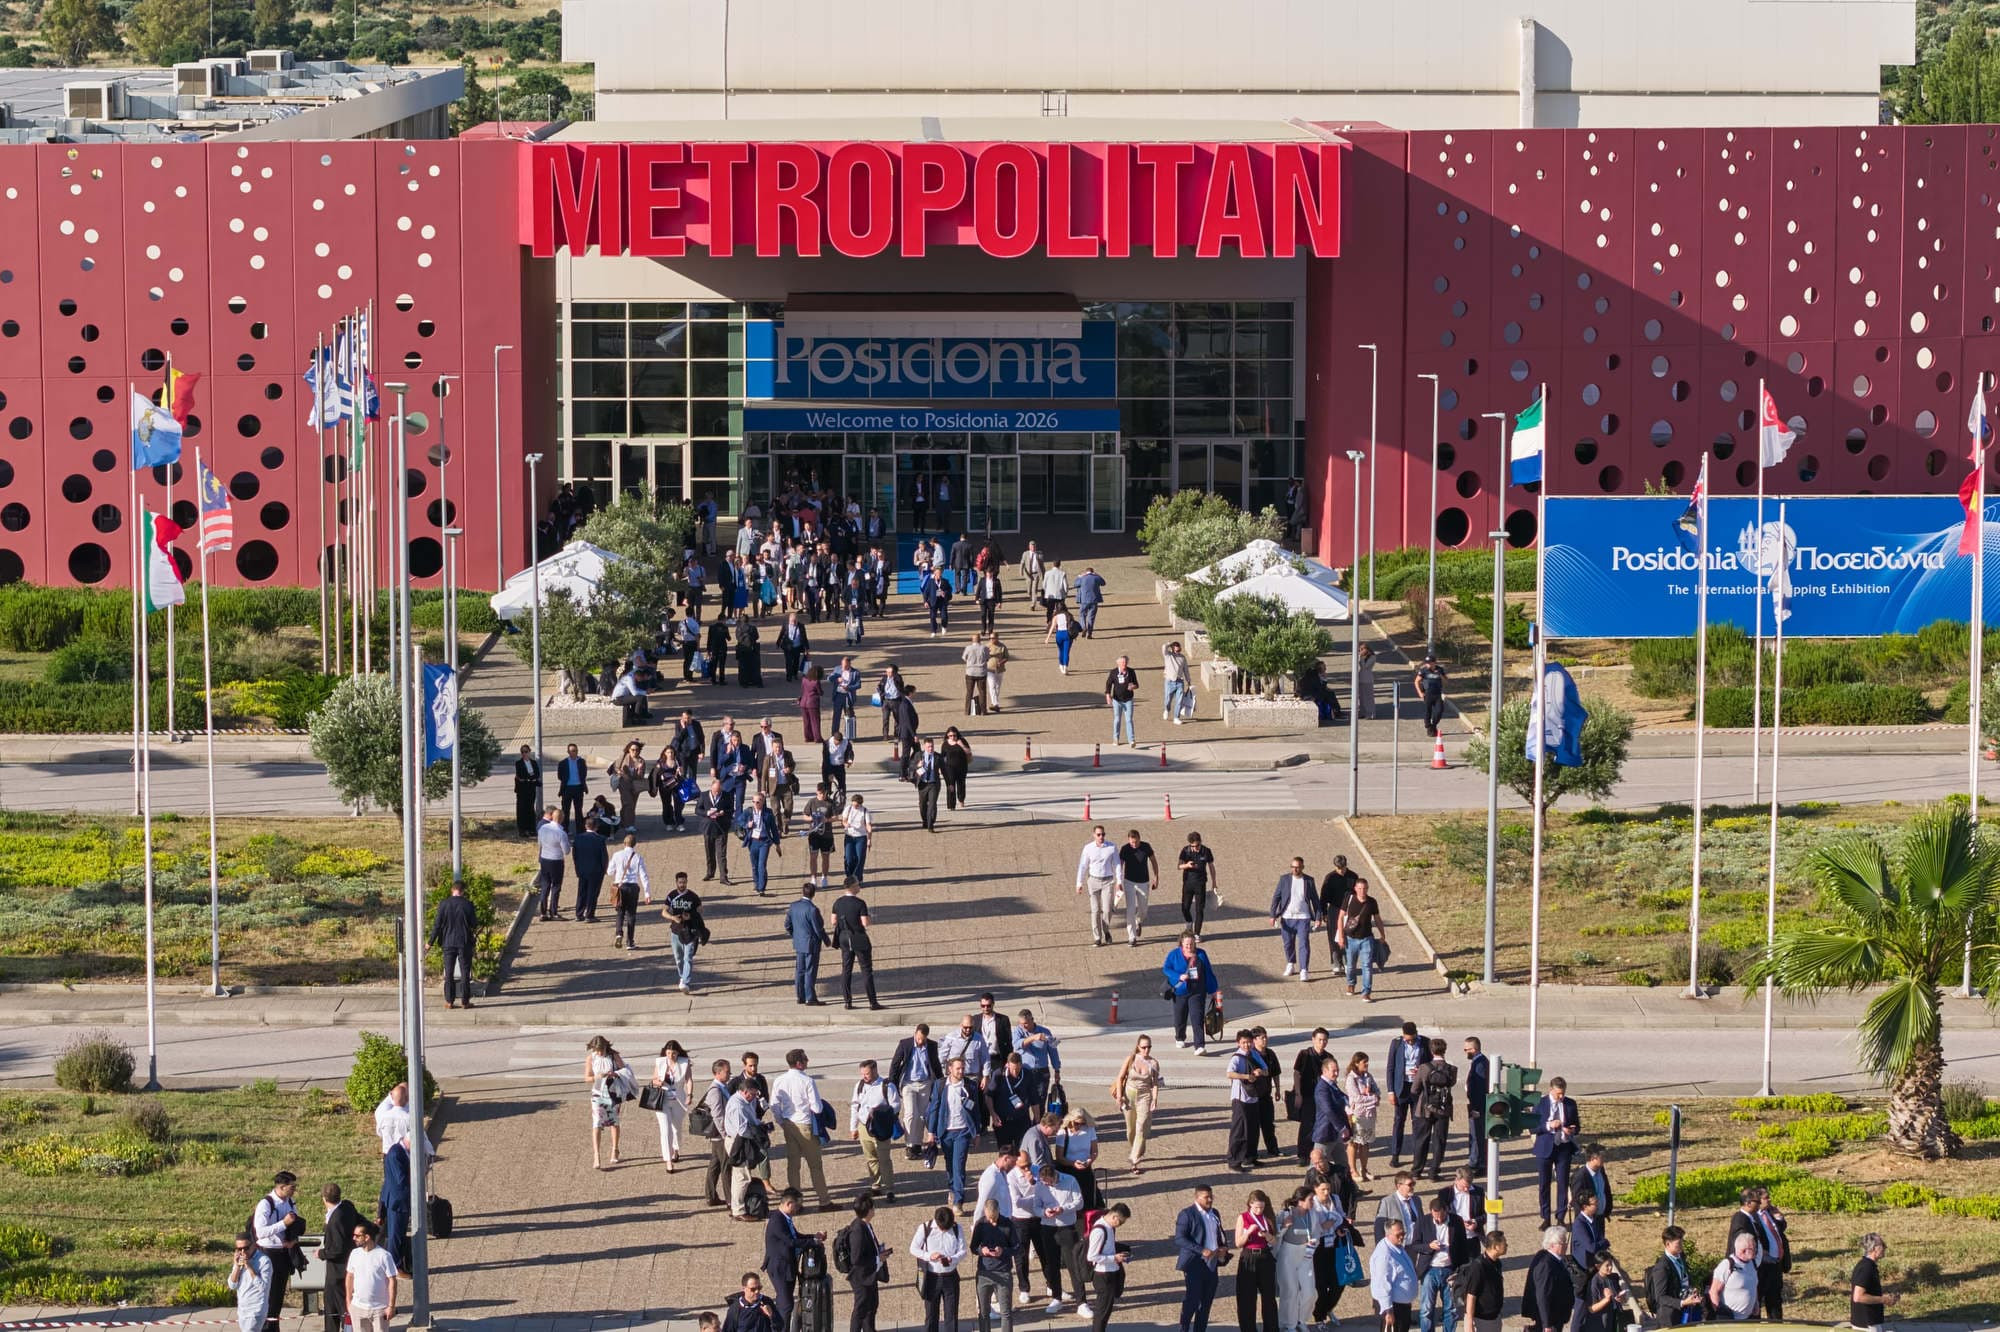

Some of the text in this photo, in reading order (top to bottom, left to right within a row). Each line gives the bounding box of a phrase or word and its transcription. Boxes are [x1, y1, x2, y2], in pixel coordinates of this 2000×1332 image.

[533, 143, 1341, 258] METROPOLITAN
[774, 328, 1087, 384] Posidonia
[806, 412, 1059, 428] Welcome to Posidonia 2026
[1795, 546, 1947, 571] Ποσειδώνια
[1667, 584, 1689, 595] The
[1831, 583, 1890, 594] Exhibition
